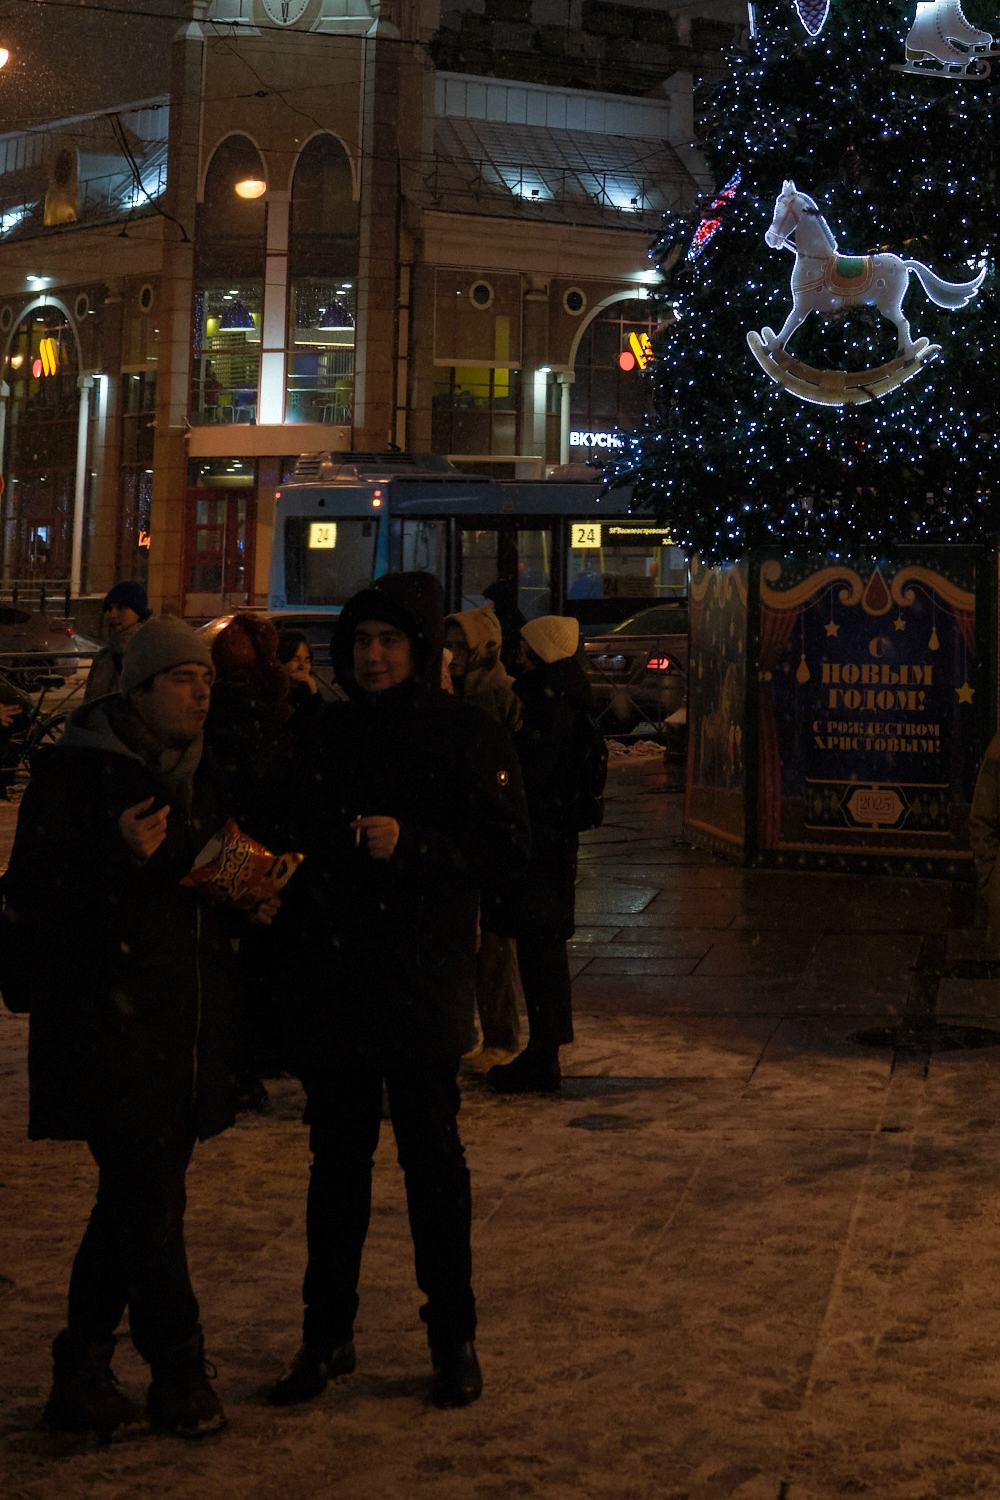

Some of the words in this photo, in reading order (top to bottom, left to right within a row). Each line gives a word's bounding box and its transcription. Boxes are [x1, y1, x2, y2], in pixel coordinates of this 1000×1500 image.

[577, 528, 595, 543] 24
[868, 636, 886, 658] С
[821, 663, 934, 686] НОВЫМ
[828, 688, 926, 714] ГОДОМ!
[811, 719, 822, 733] С
[827, 720, 941, 737] РОЖДЕСТВОМ
[813, 735, 942, 753] ХРИСТОВЫМ!
[860, 797, 891, 811] 2025
